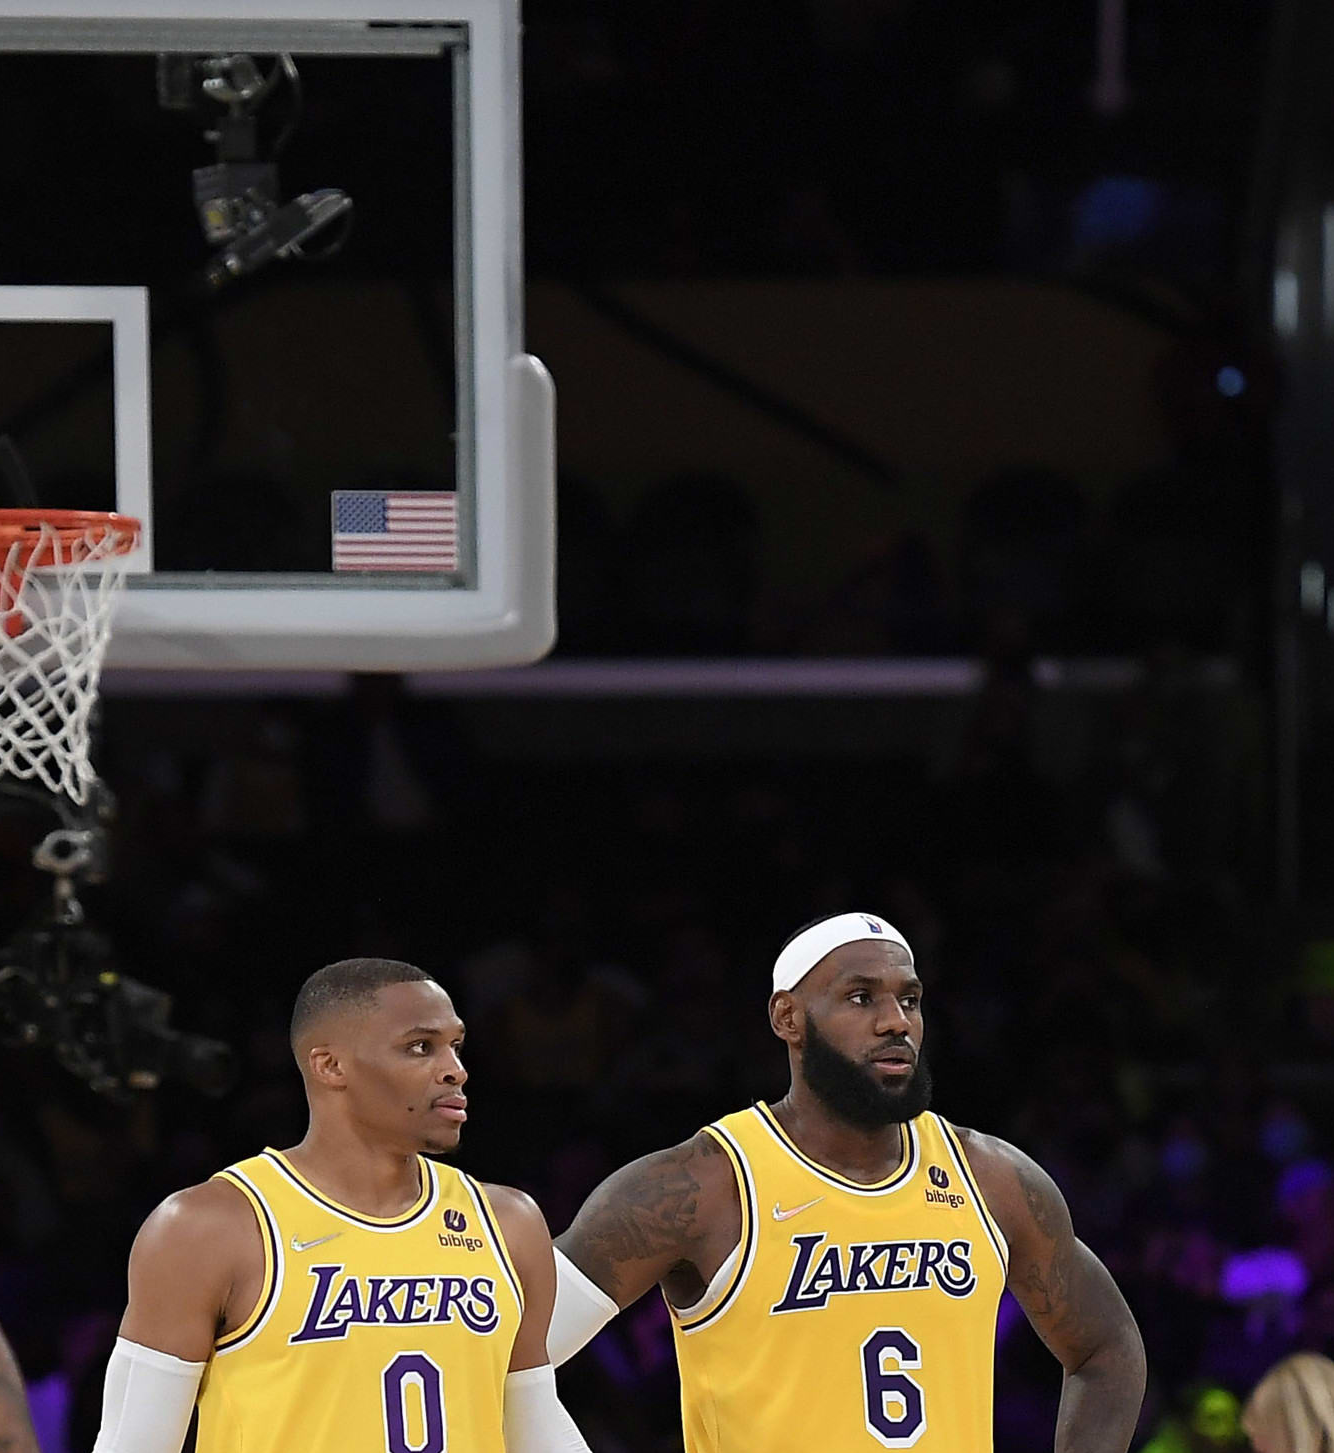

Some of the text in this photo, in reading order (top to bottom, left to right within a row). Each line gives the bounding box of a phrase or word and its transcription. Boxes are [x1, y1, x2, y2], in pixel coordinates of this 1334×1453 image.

[926, 1189, 966, 1209] bibigo
[438, 1233, 484, 1252] bibigo
[769, 1231, 977, 1316] LAKERS
[286, 1264, 501, 1345] LAKERS
[860, 1326, 927, 1448] 6
